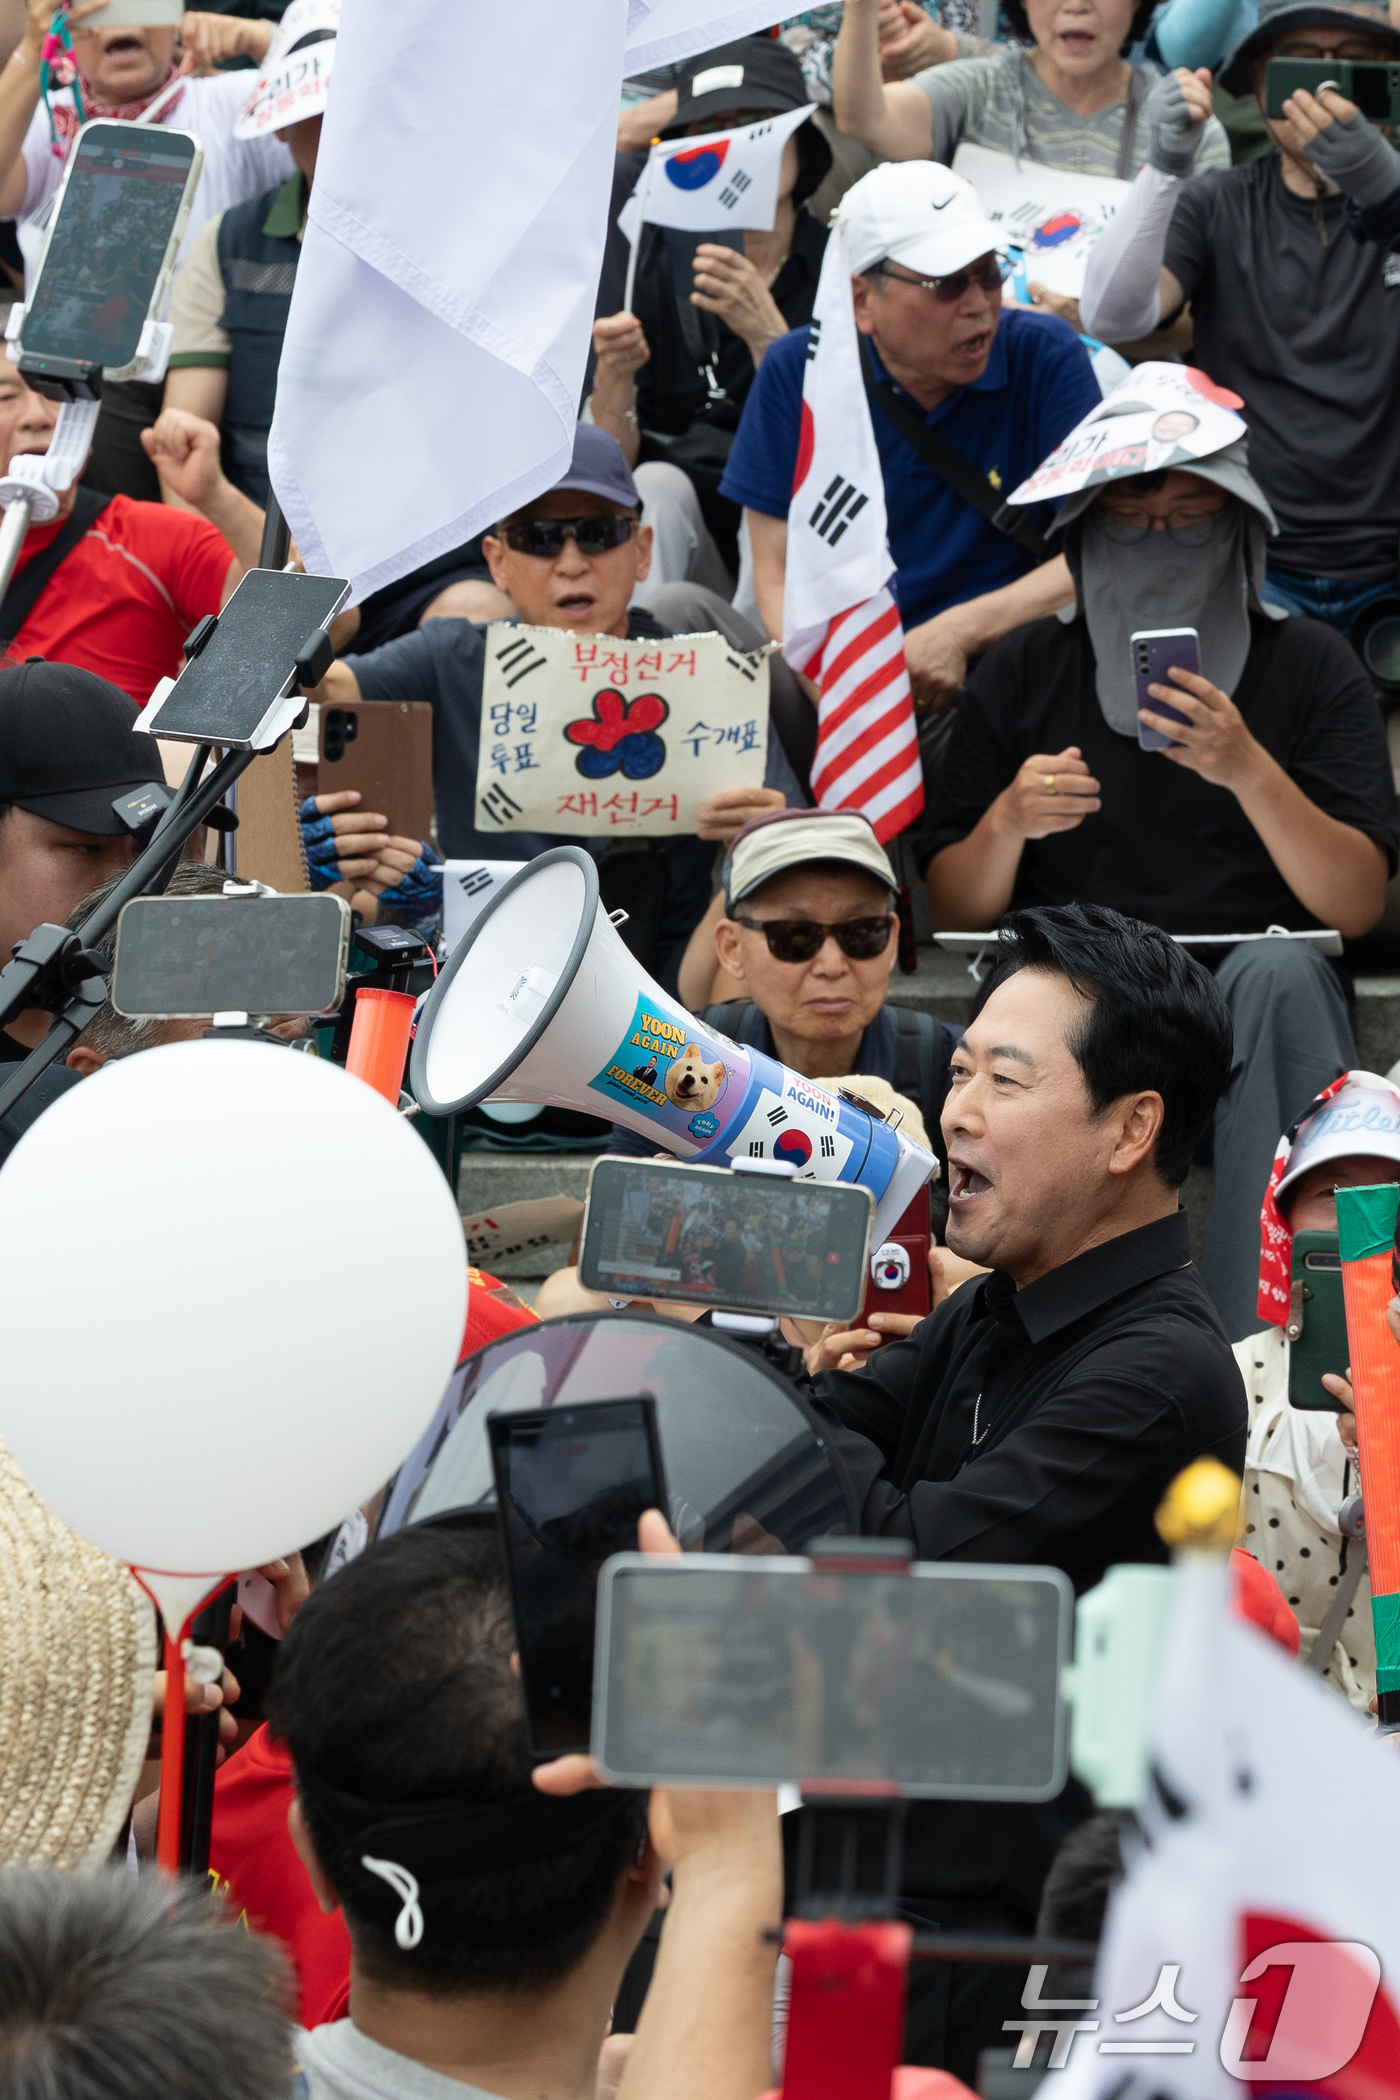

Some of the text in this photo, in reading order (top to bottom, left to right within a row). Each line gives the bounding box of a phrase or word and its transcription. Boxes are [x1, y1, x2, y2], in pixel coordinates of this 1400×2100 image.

[572, 643, 696, 686] 부정선거
[490, 701, 537, 735] 당일
[681, 719, 762, 757] 수개표
[490, 742, 541, 775] 투표
[556, 791, 679, 825] 재선거
[630, 1031, 679, 1060] AGAIN
[641, 1012, 686, 1046] YOON
[605, 1063, 669, 1107] FOREVER
[793, 1075, 832, 1107] YOON
[787, 1086, 835, 1123] AGAIN!
